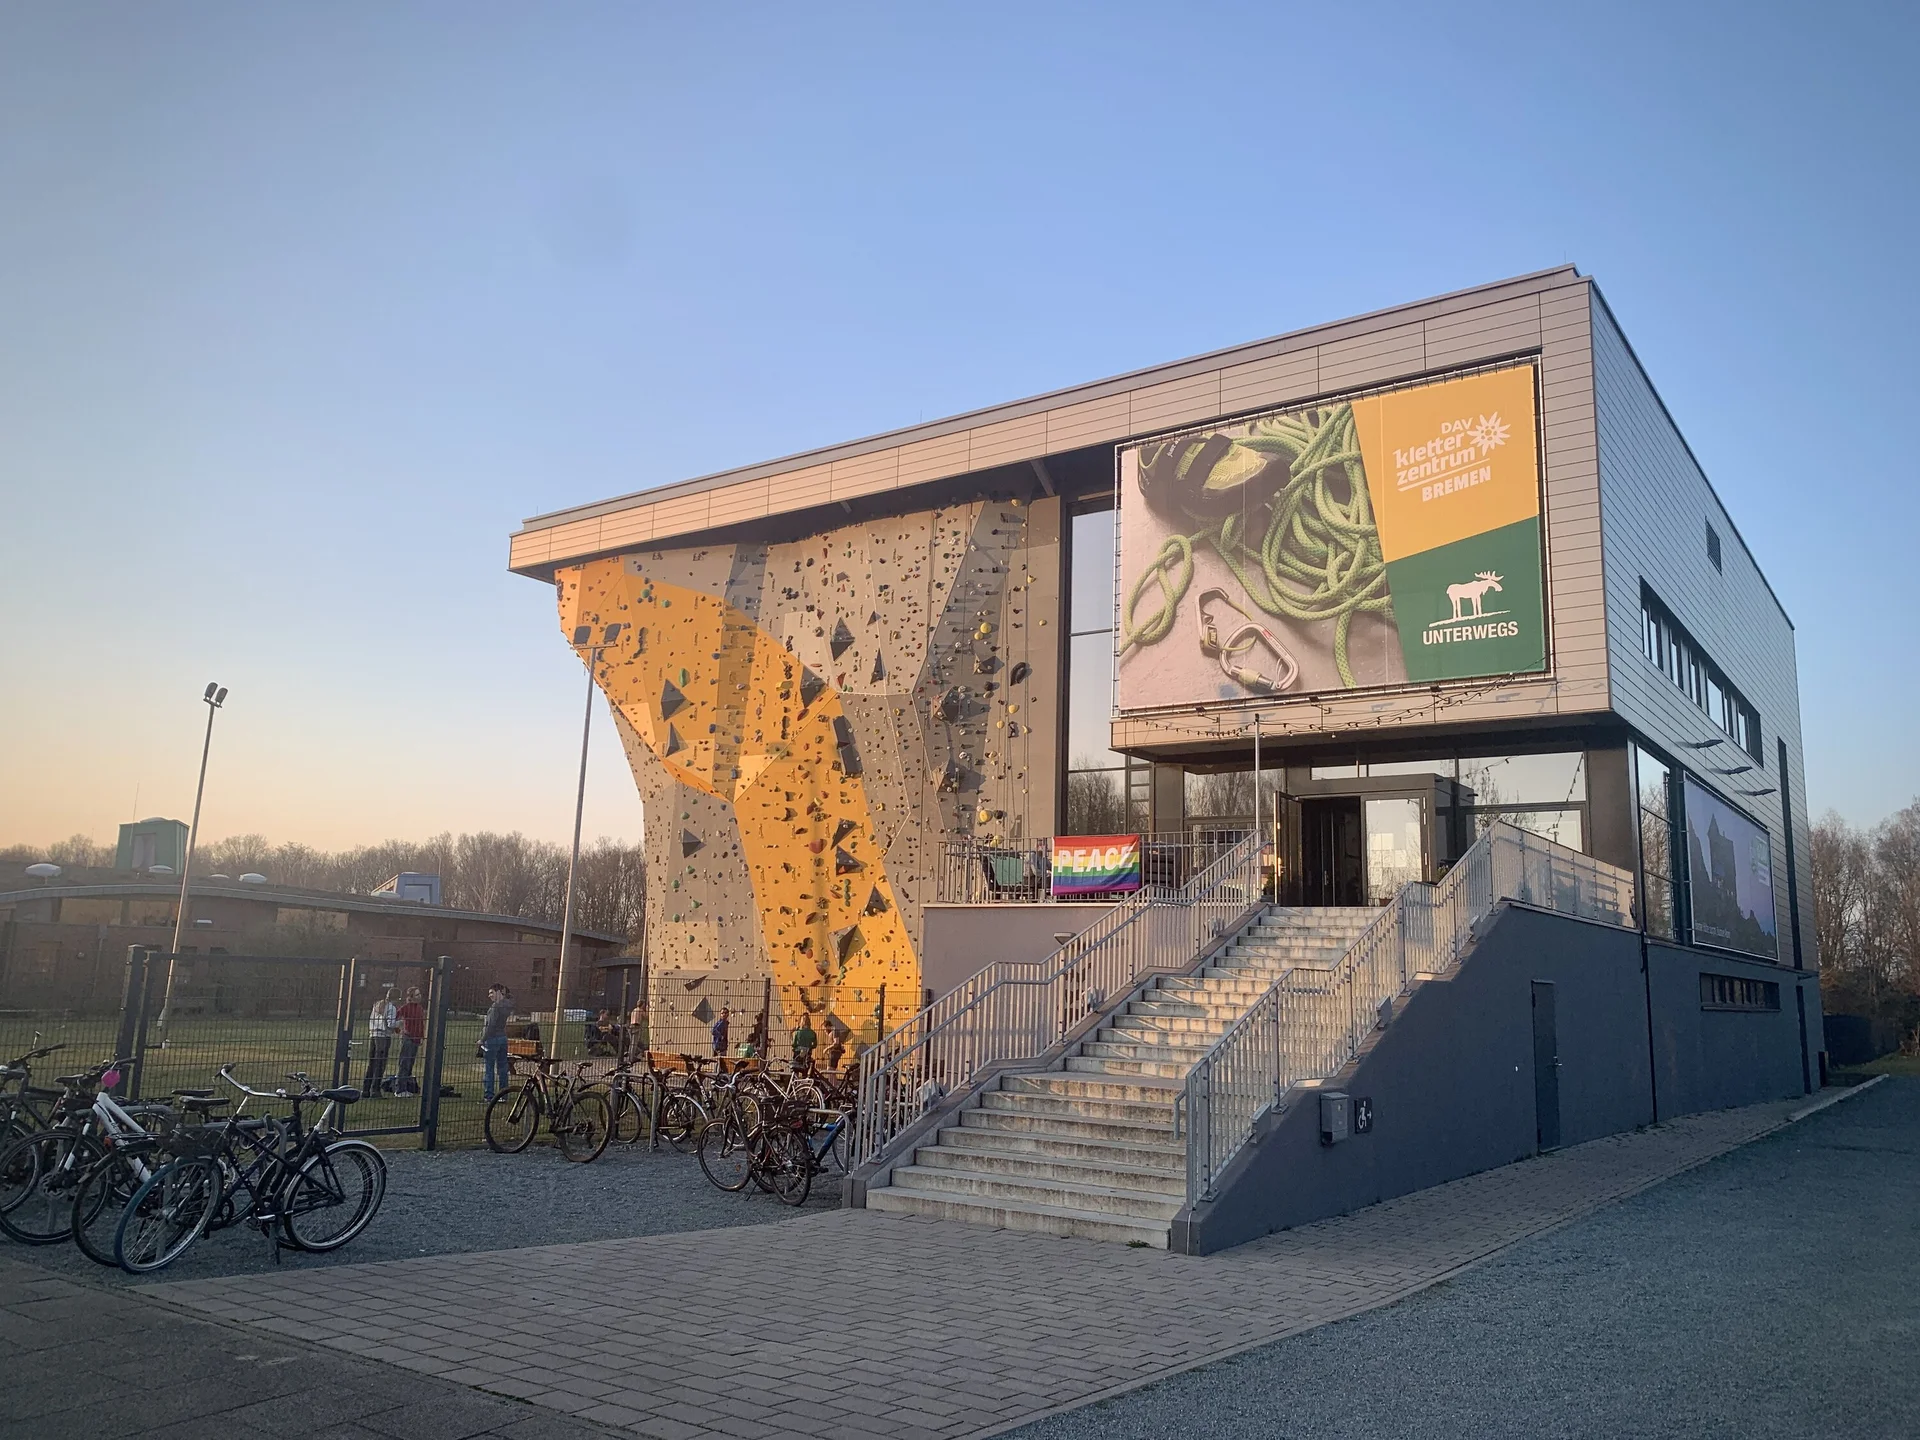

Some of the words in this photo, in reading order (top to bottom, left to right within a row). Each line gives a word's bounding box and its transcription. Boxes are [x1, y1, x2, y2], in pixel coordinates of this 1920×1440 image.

[1441, 417, 1473, 434] DAV
[1392, 432, 1465, 469] kletter
[1396, 446, 1476, 486] zentrum
[1421, 465, 1491, 502] BREMEN
[1422, 620, 1519, 645] UNTERWEGS
